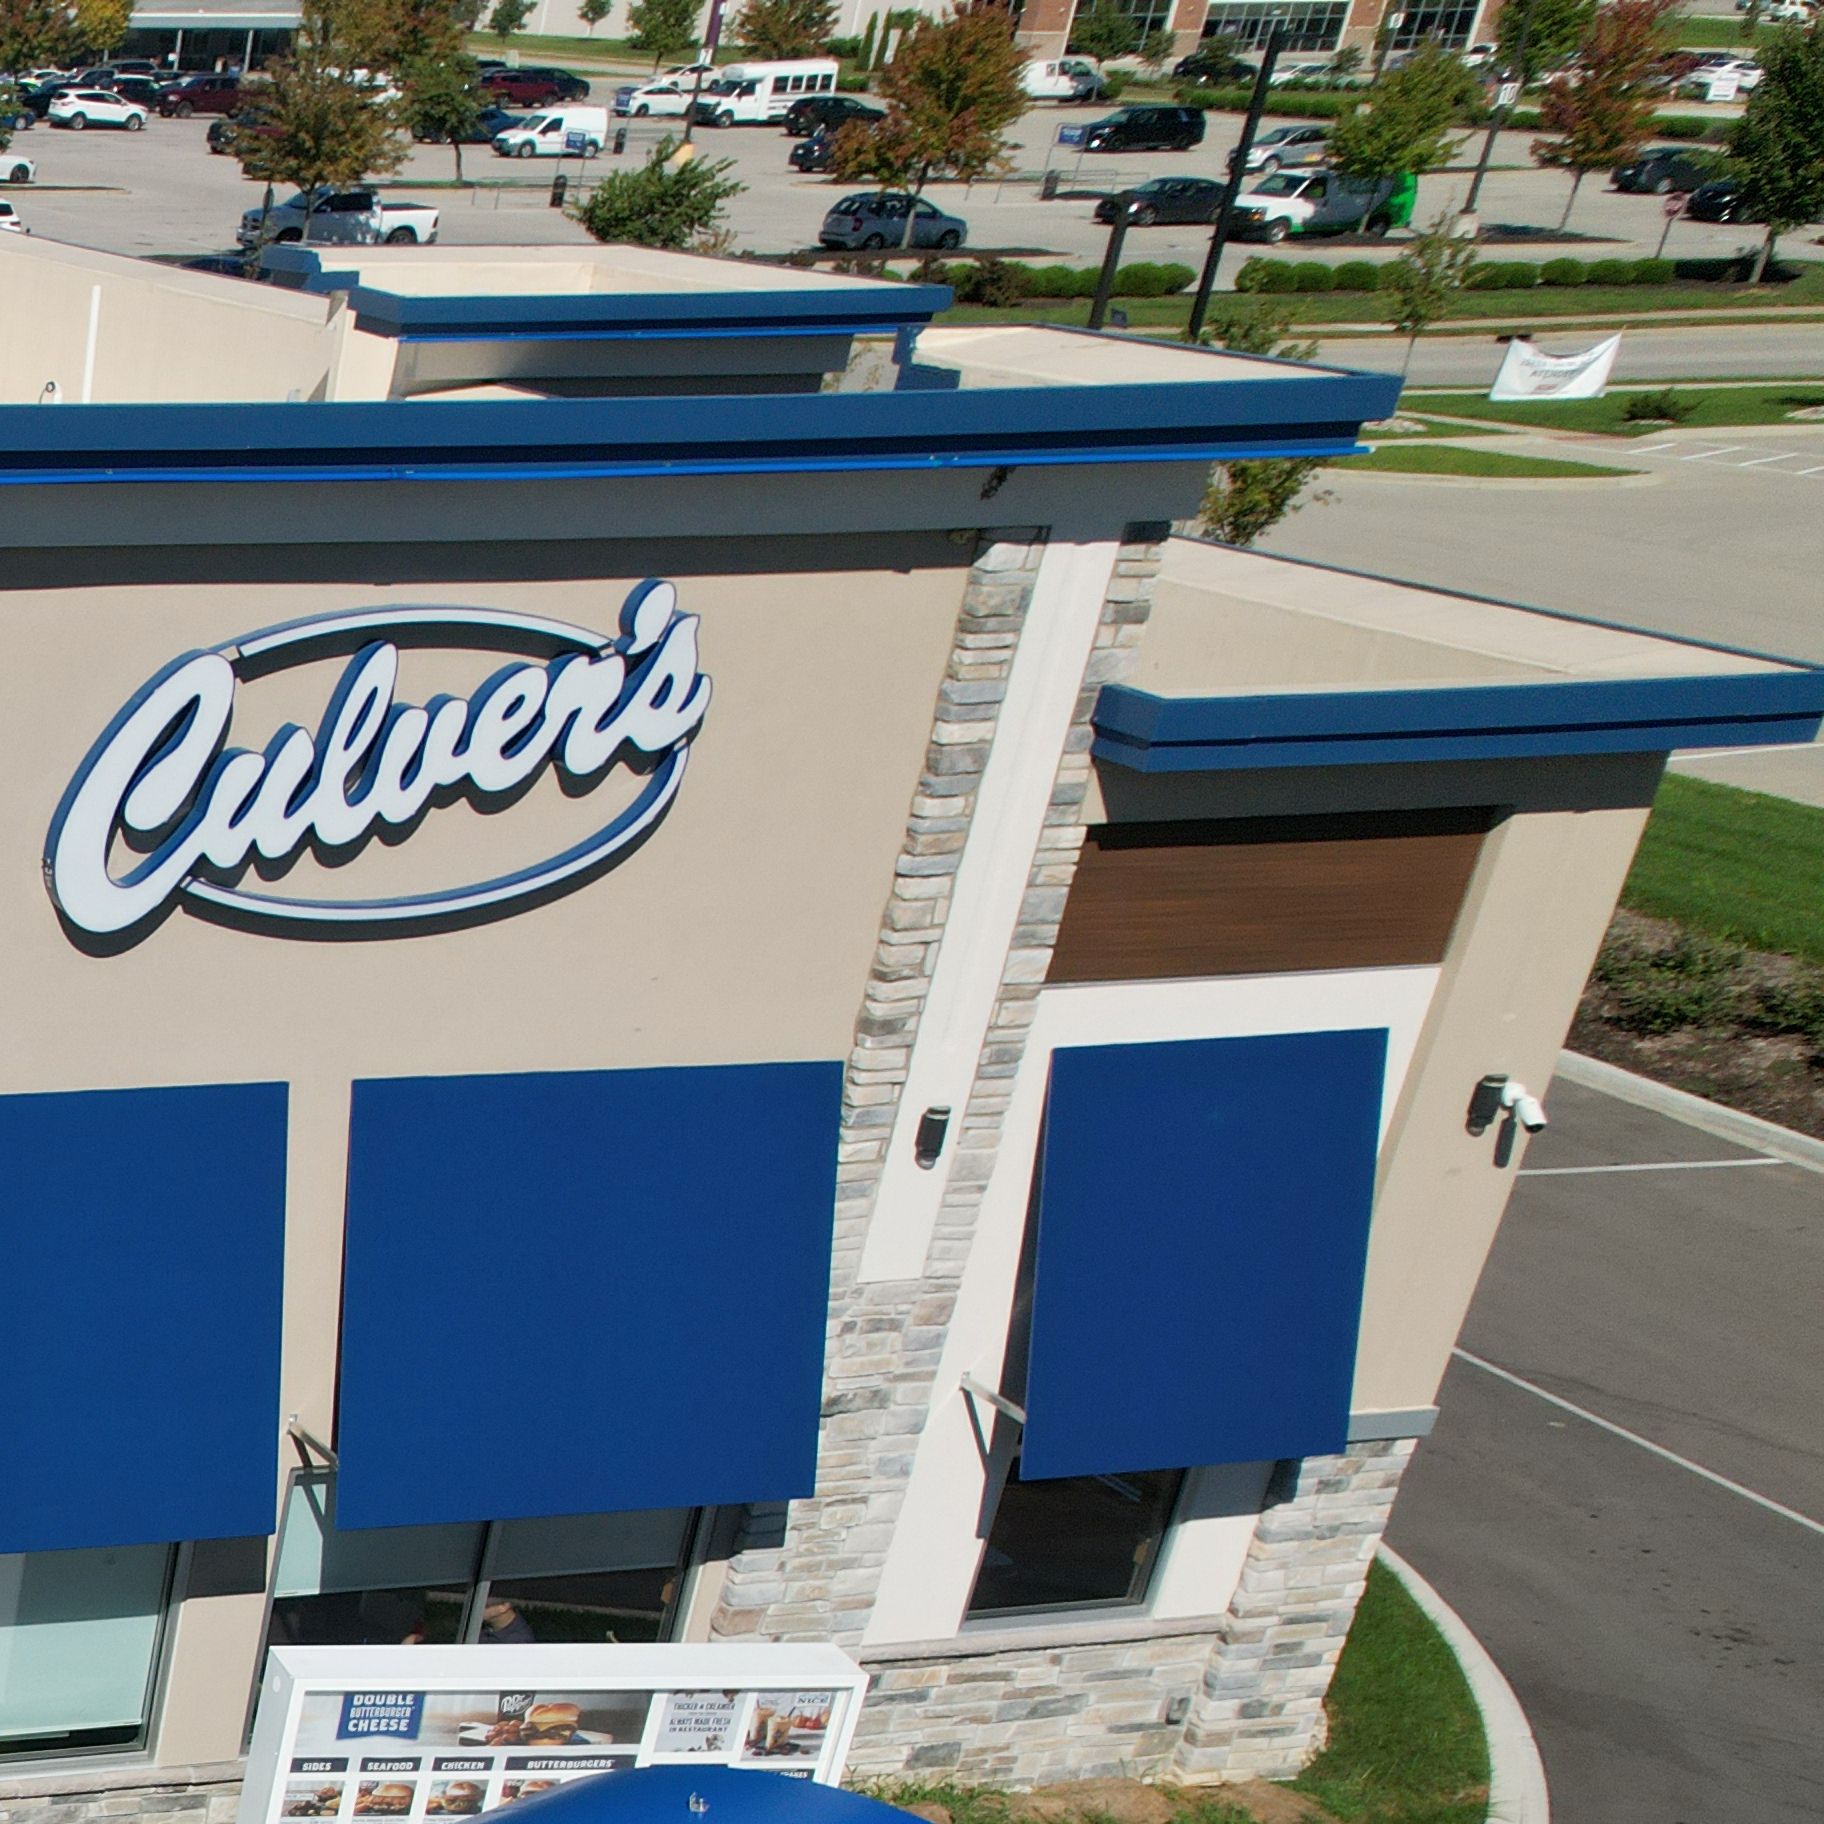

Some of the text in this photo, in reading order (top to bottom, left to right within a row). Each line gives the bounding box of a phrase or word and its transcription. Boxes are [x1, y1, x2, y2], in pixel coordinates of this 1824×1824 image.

[44, 578, 711, 934] Culver's
[353, 1694, 415, 1705] DOUBLE
[348, 1719, 410, 1732] CHEESE
[302, 1762, 331, 1771] SIDES
[367, 1762, 413, 1771] SEAFOOD
[441, 1761, 485, 1770] CHICKEN
